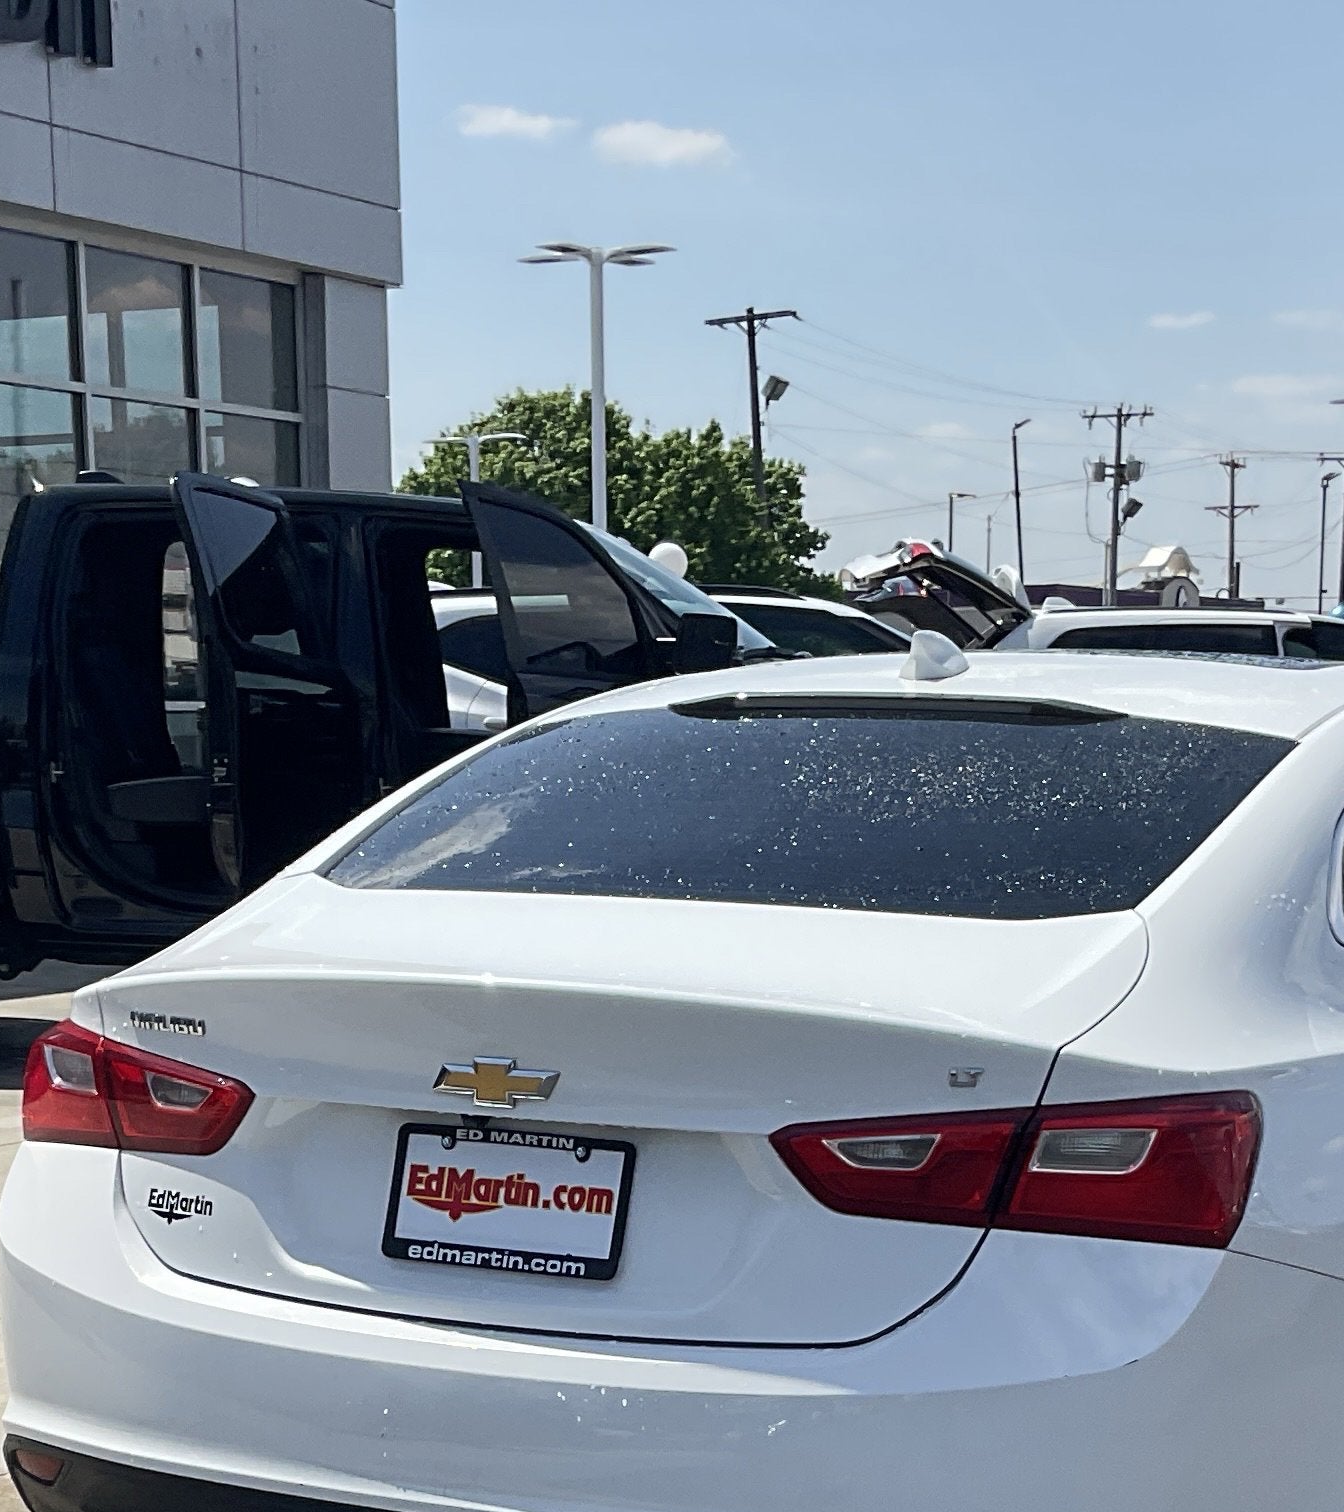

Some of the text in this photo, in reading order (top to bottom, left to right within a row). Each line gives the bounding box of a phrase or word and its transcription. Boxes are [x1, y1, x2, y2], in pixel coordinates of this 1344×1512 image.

[456, 1128, 575, 1150] ED MARTIN
[147, 1188, 213, 1217] EdMartin
[406, 1163, 615, 1216] EdMartin.com
[407, 1243, 586, 1276] edmartin.com
